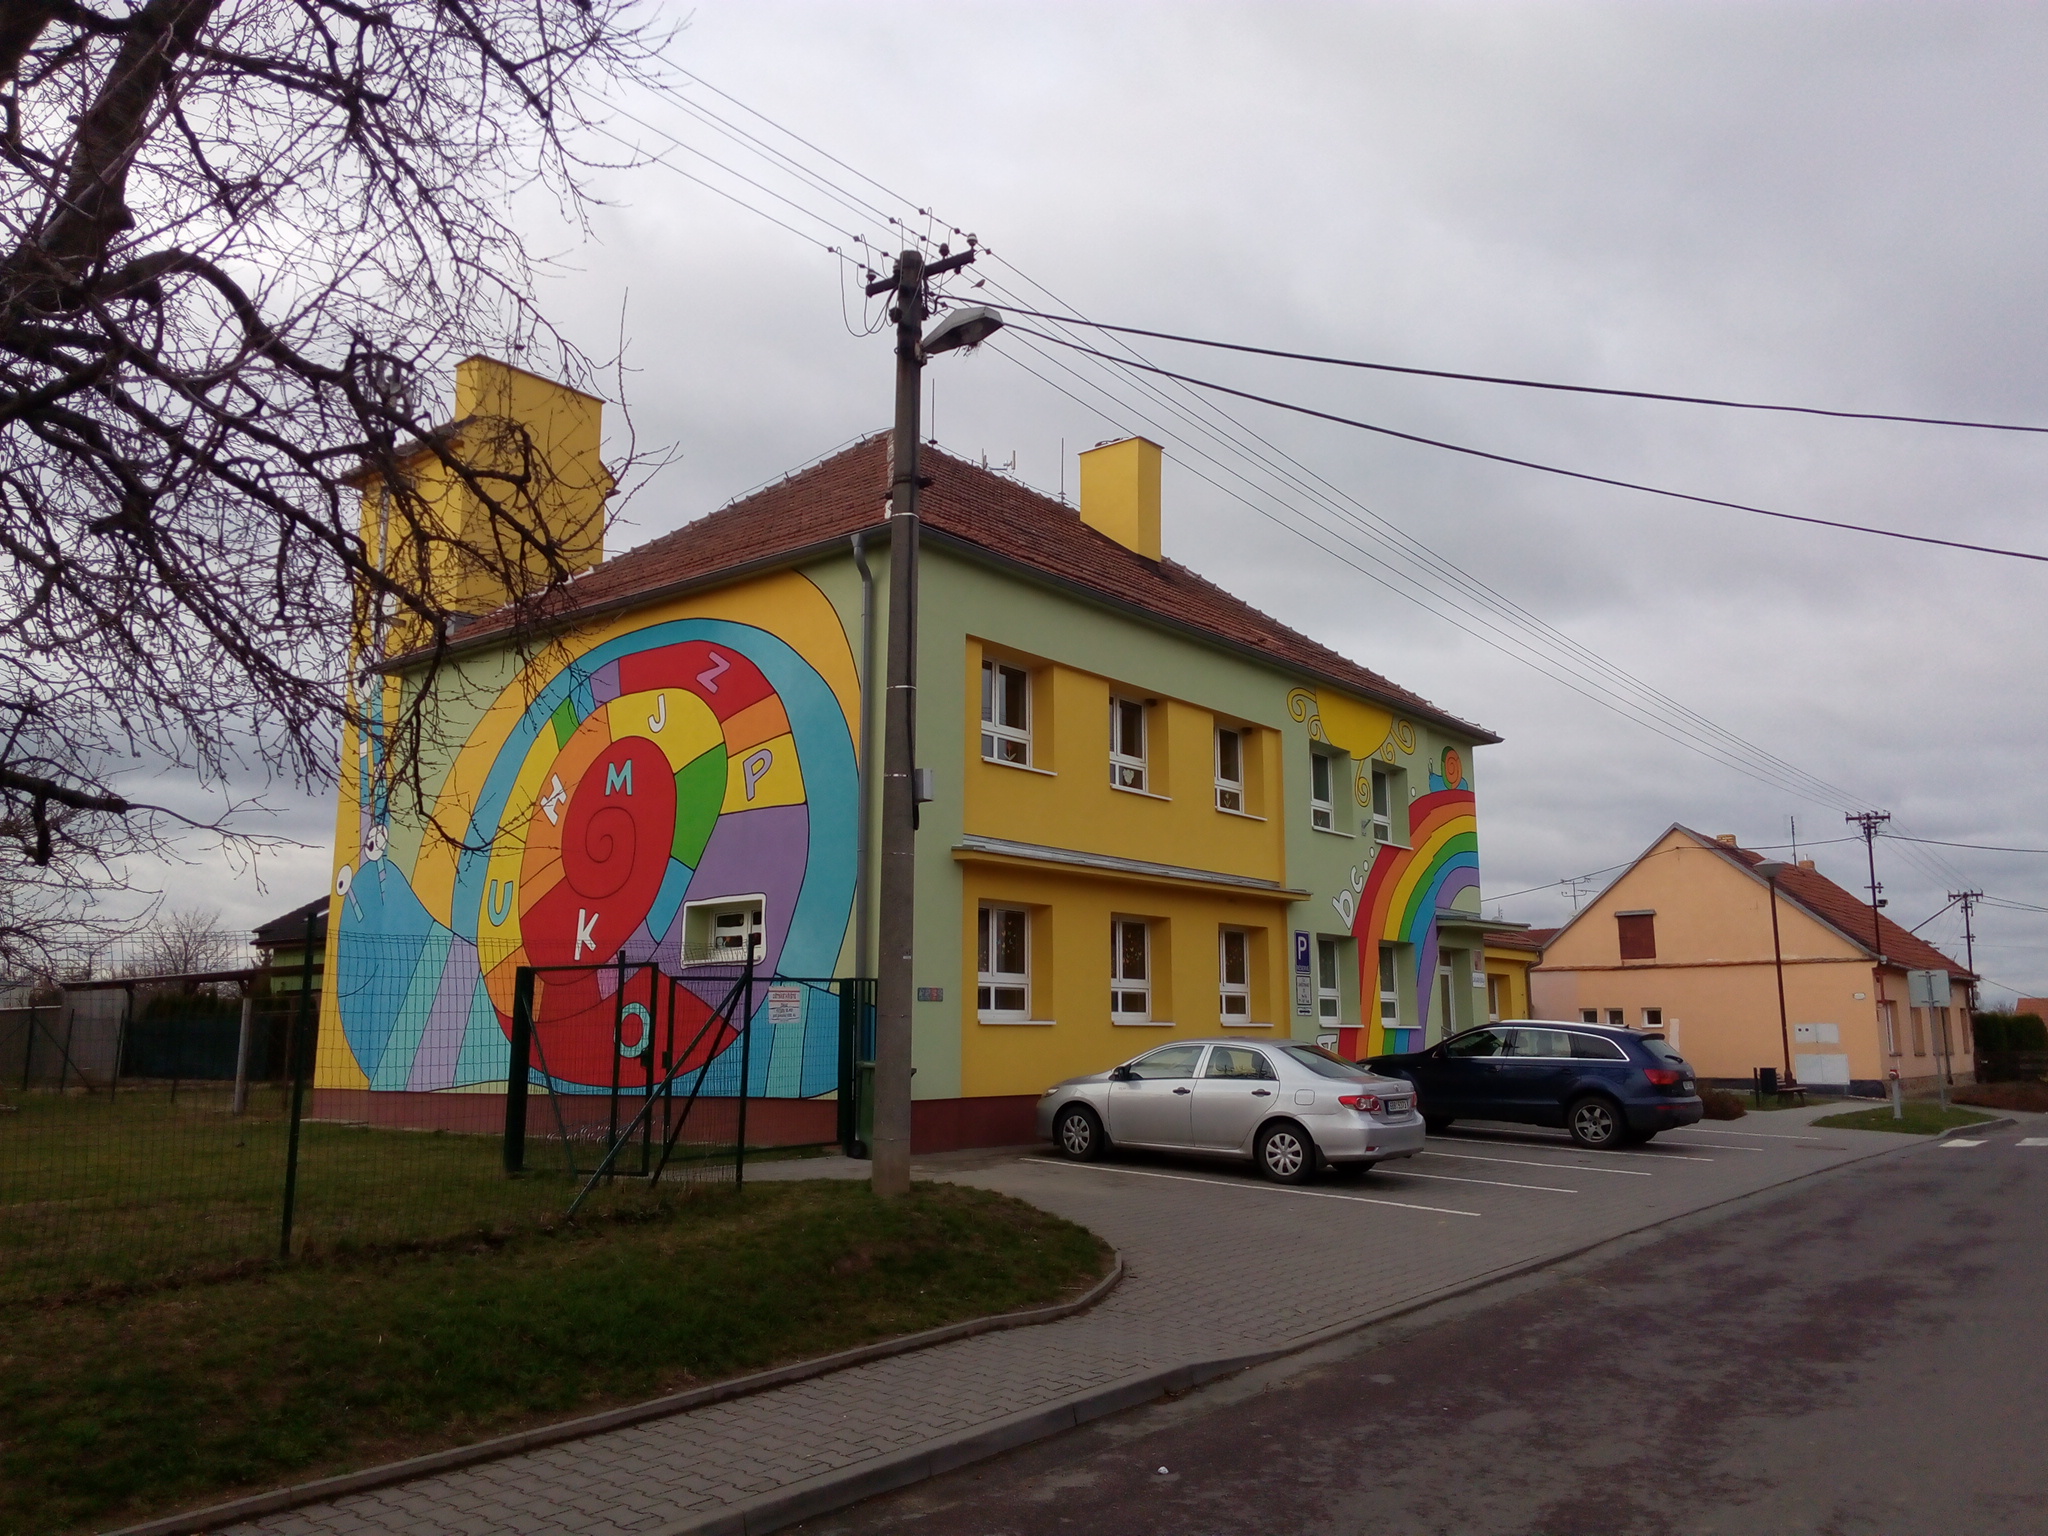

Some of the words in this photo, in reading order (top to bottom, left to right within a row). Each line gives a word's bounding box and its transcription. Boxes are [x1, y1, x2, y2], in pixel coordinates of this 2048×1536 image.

[696, 650, 731, 695] Z
[647, 692, 667, 734] J
[604, 759, 633, 796] M
[742, 748, 773, 802] P
[487, 878, 514, 927] U
[574, 908, 600, 961] K
[1297, 936, 1308, 960] P
